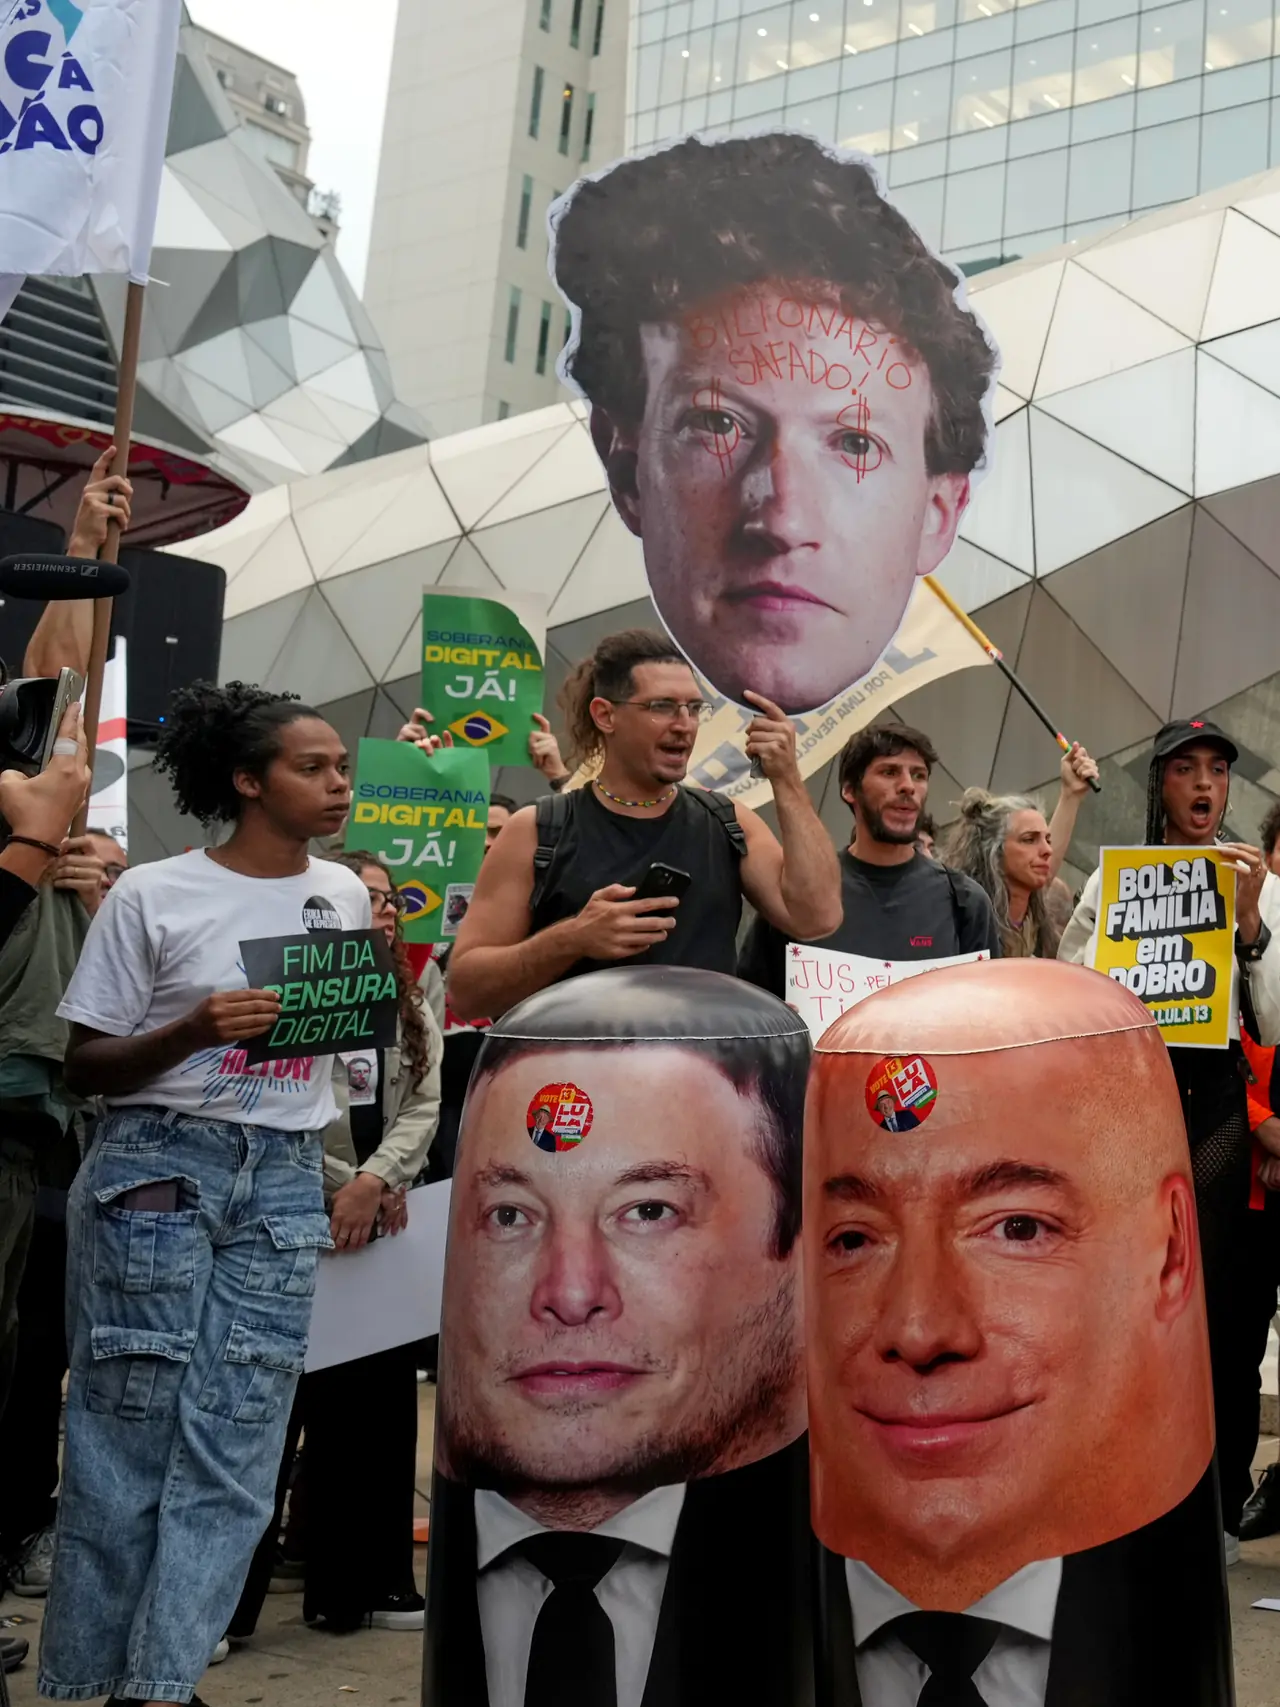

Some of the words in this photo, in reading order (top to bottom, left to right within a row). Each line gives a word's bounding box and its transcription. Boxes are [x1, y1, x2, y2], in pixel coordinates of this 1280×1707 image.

[13, 563, 77, 573] SENNHEISER
[425, 645, 542, 671] DIGITAL
[445, 670, 517, 702] JÁ!
[359, 783, 486, 804] SOBERANIA
[354, 802, 486, 829] DIGITAL
[378, 831, 457, 867] JÁ!
[1118, 857, 1210, 902] BOLSA
[1106, 881, 1218, 936] FAMÍLIA
[283, 944, 334, 976] FIM
[340, 940, 375, 971] DA
[1135, 934, 1185, 964] em
[1108, 959, 1207, 997] DOBRO
[268, 1008, 375, 1047] DIGITAL
[1194, 1004, 1209, 1021] 13
